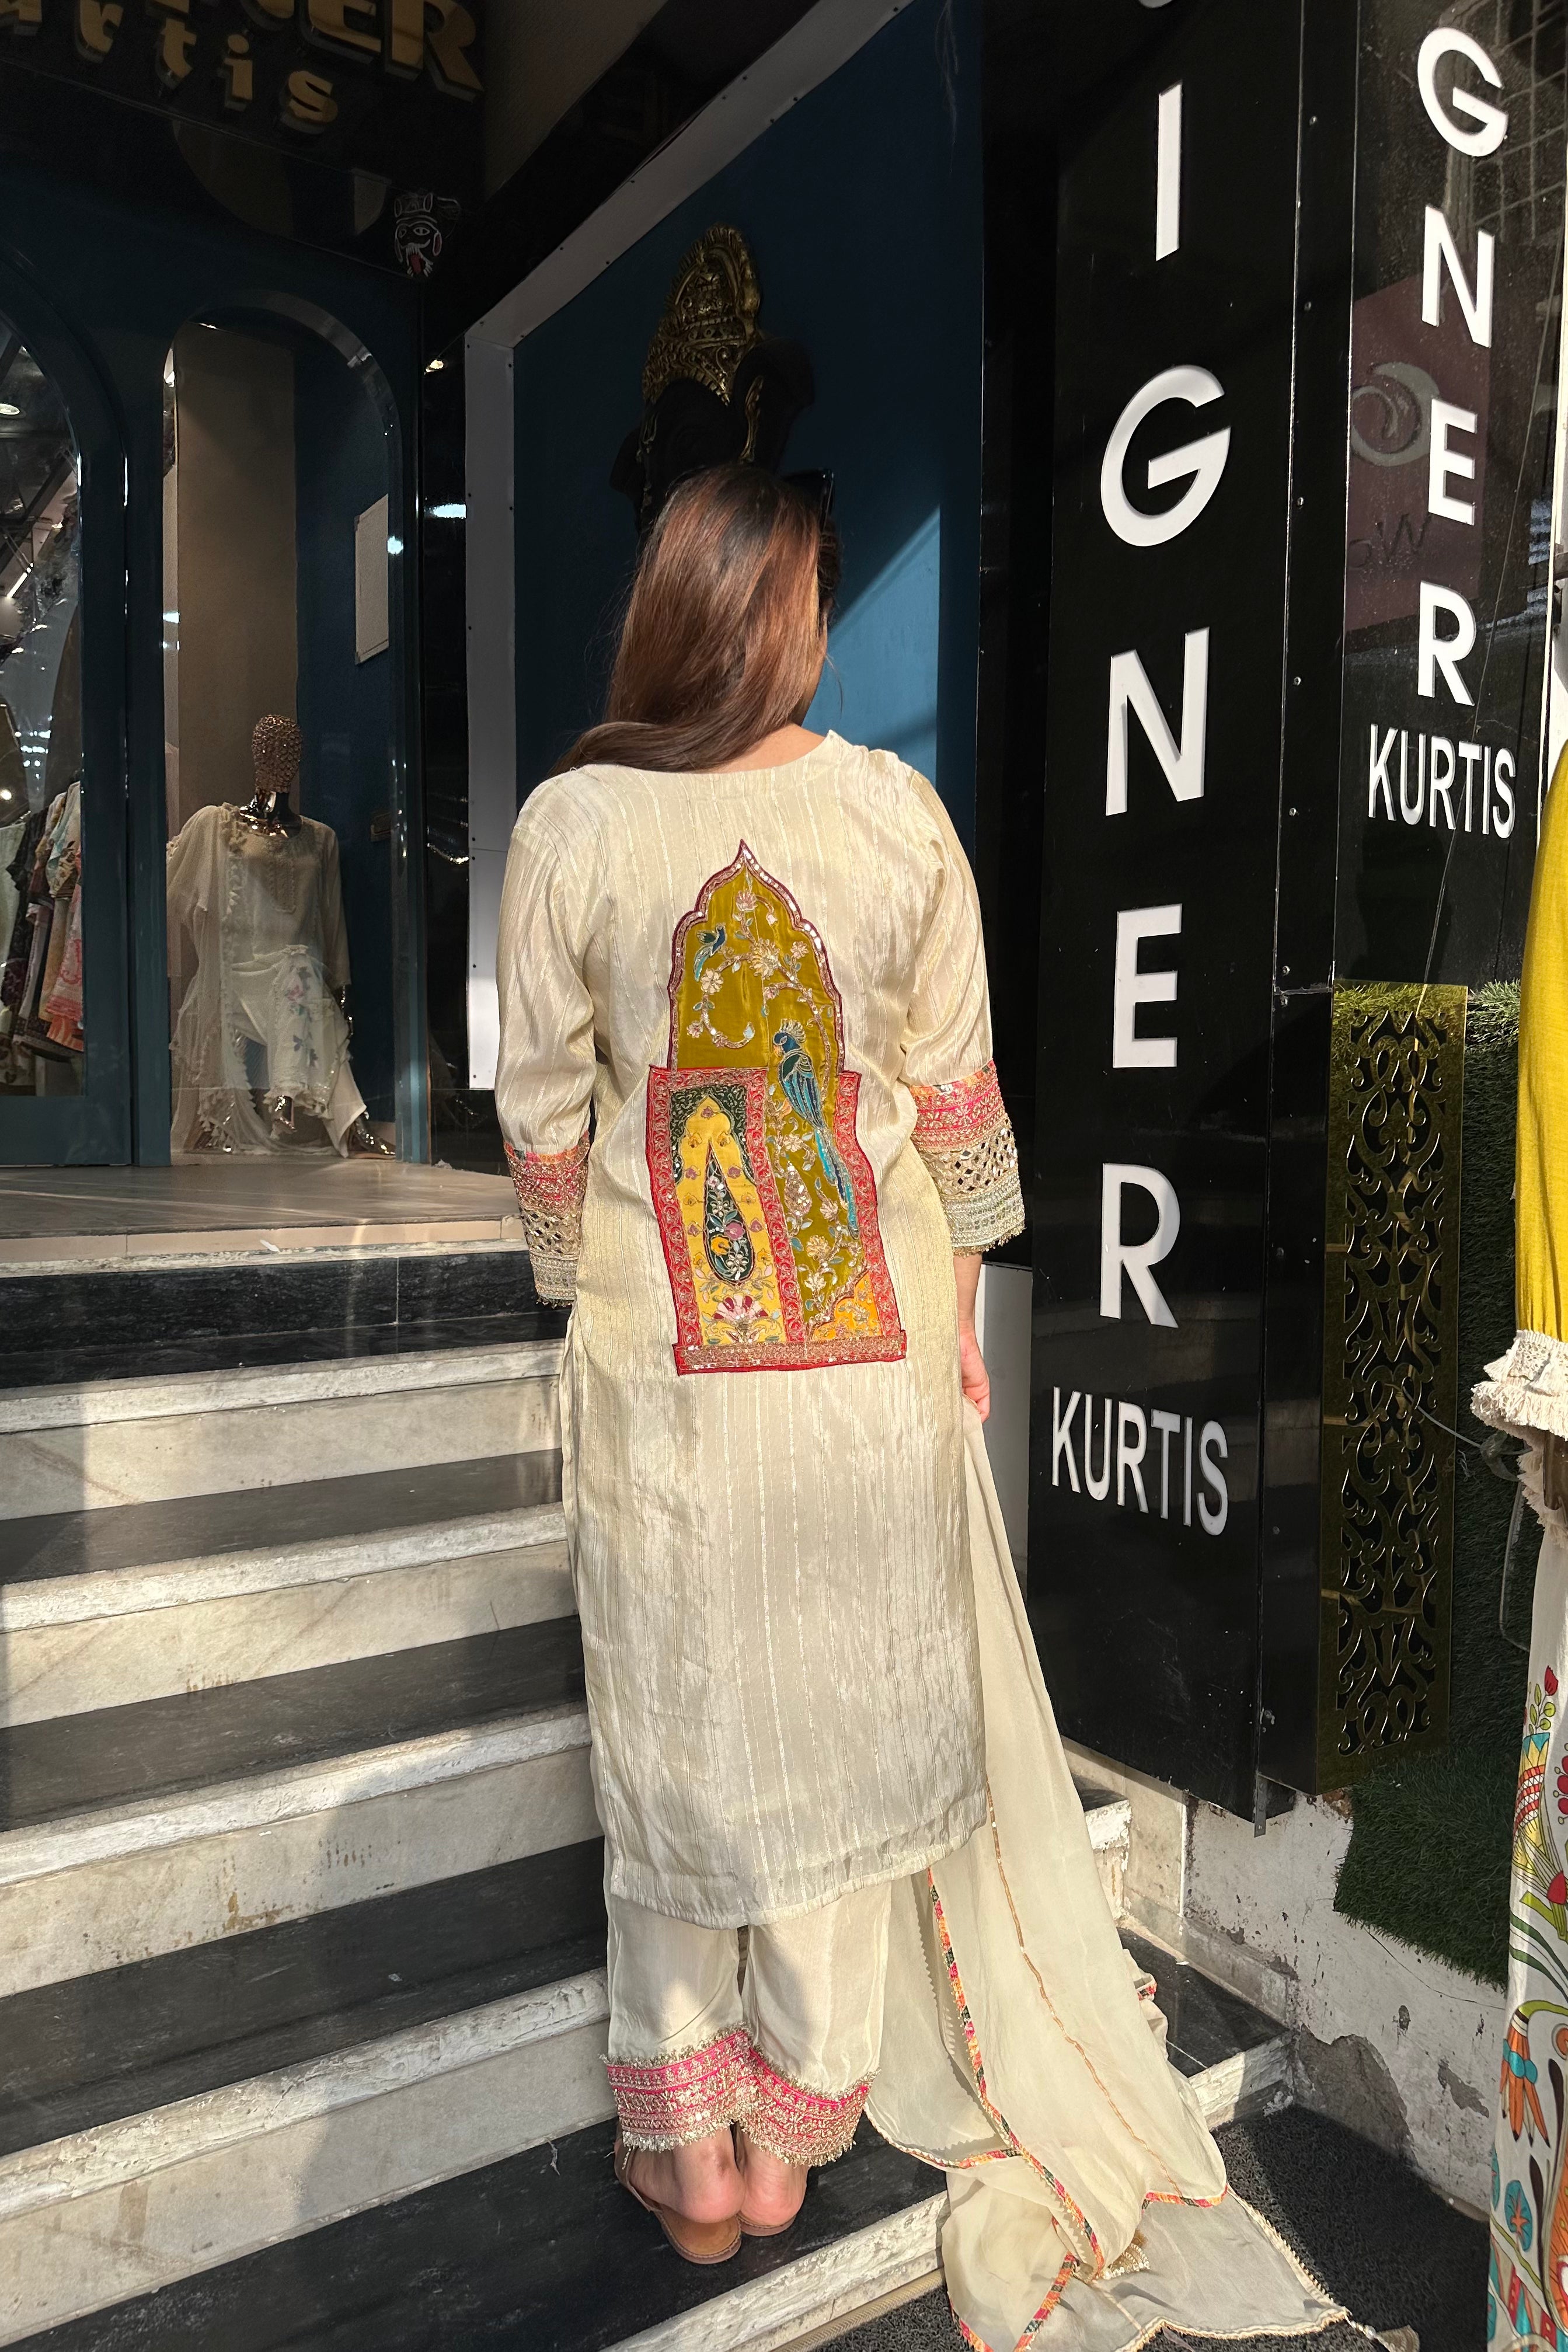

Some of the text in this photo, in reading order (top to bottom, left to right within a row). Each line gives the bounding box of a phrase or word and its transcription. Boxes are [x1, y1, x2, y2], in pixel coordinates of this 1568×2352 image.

[146, 0, 485, 92] ER
[1417, 27, 1508, 706] GNER
[1099, 0, 1230, 1327] IGNER
[1368, 724, 1516, 839] KURTIS
[1052, 1386, 1228, 1536] KURTIS
